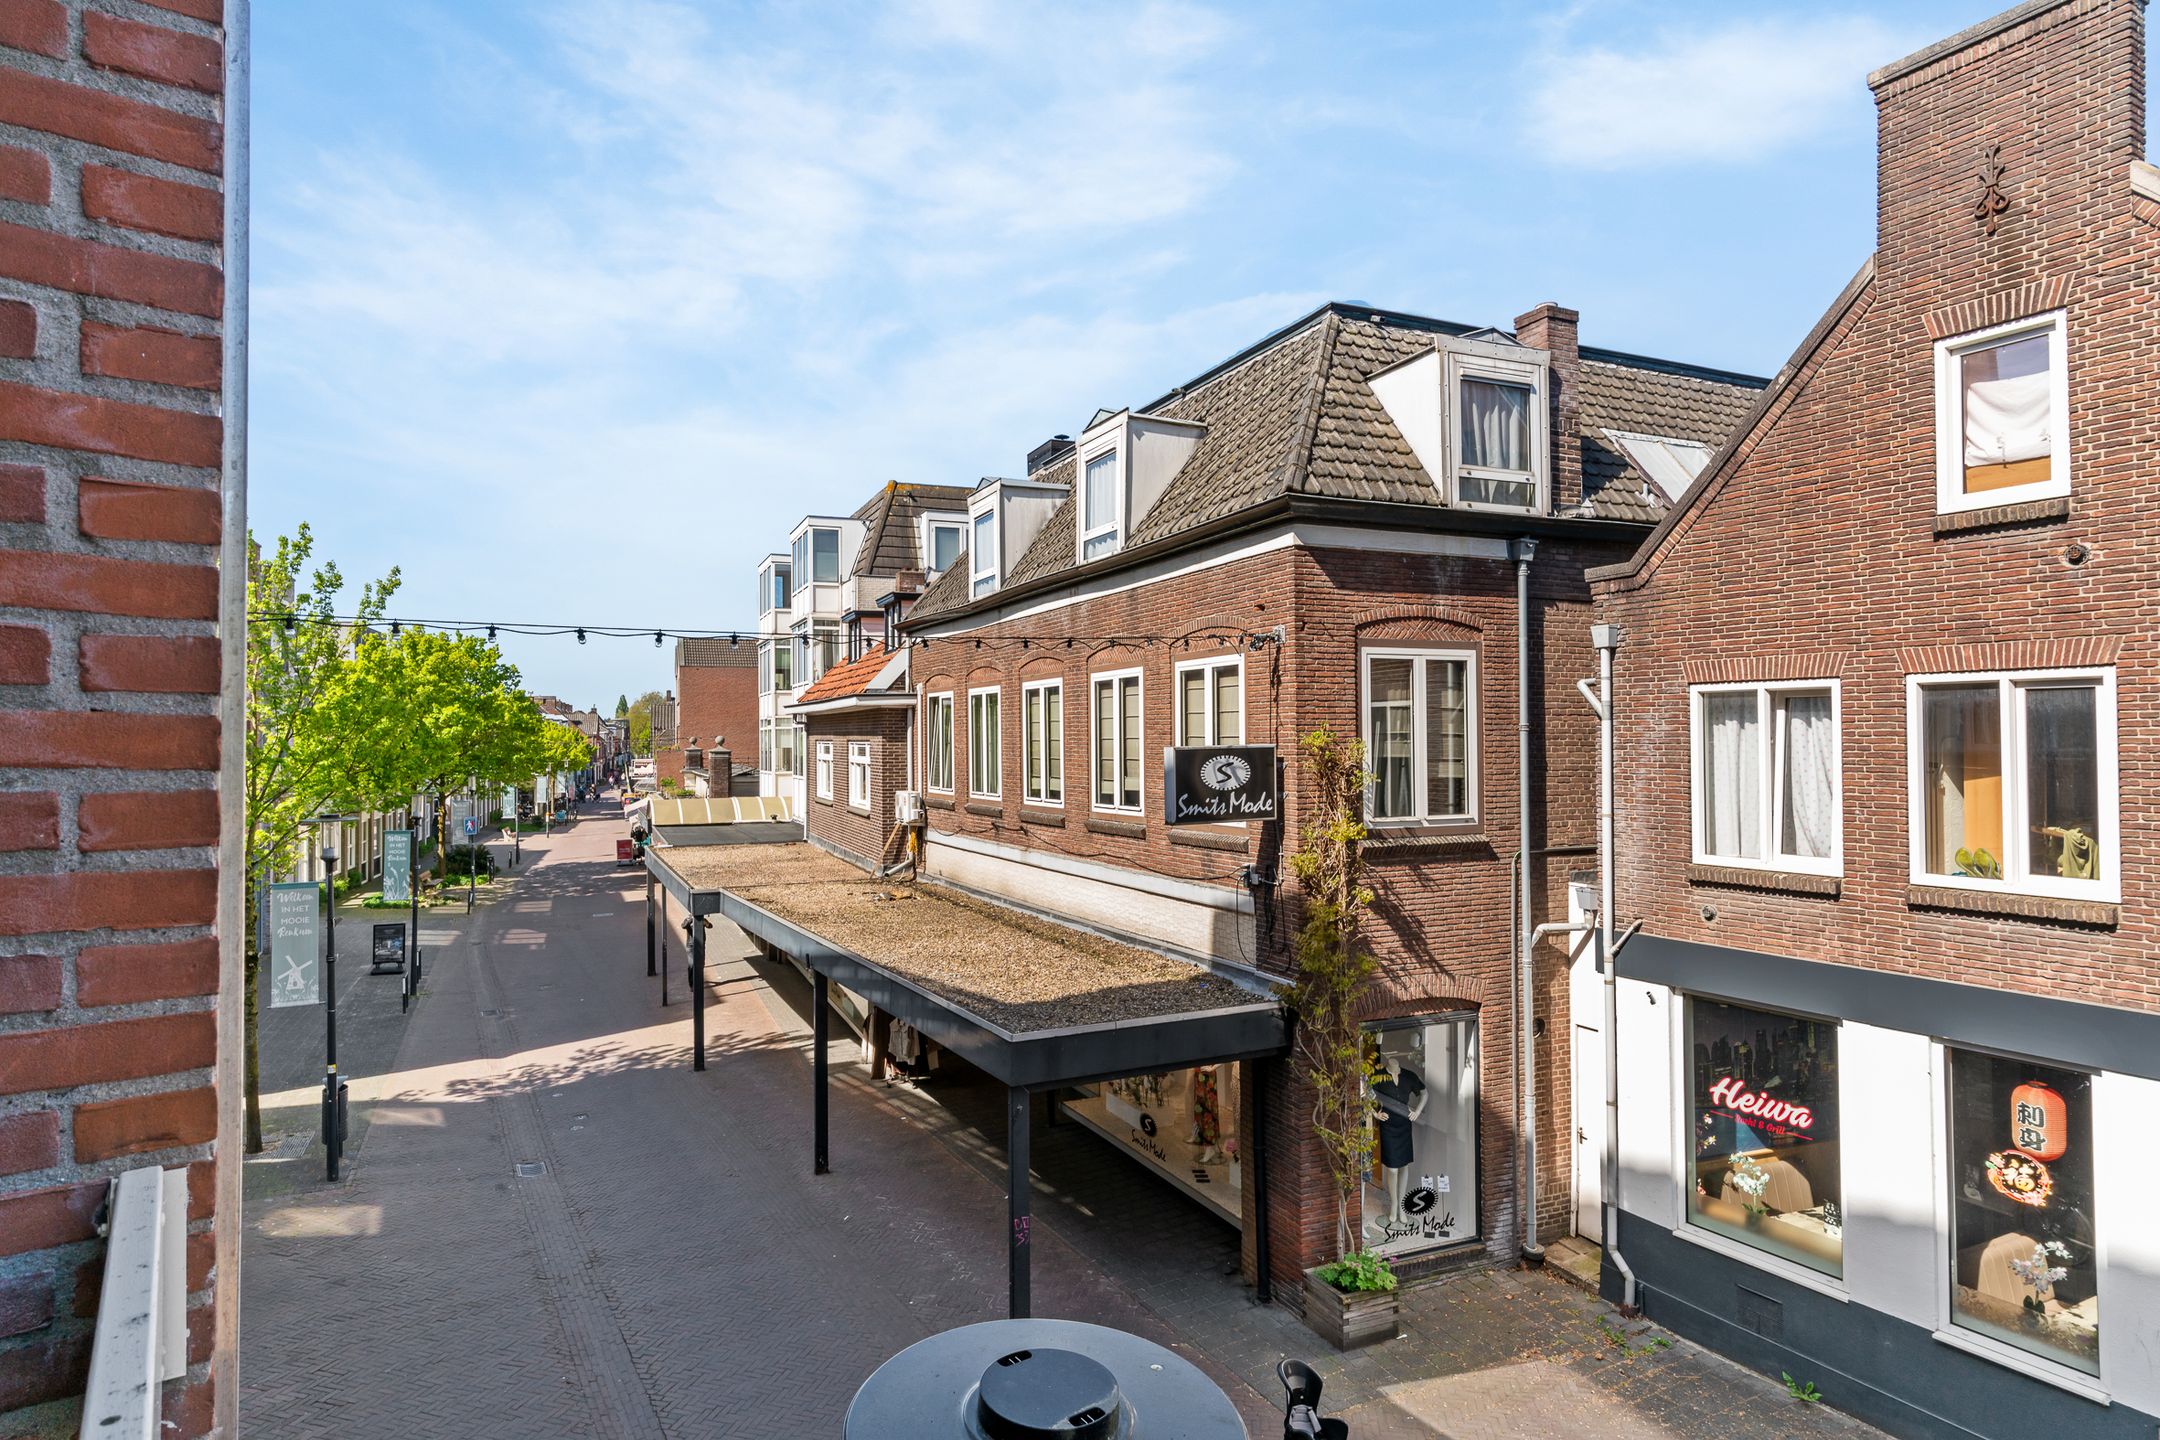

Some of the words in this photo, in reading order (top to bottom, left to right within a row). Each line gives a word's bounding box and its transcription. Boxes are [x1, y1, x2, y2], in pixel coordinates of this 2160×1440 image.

[1178, 793, 1227, 818] Smits
[1229, 791, 1273, 814] Mode
[292, 904, 310, 913] HET
[281, 916, 311, 926] MOOIE
[1709, 1076, 1813, 1129] Heiwa
[1766, 1122, 1786, 1135] Grill
[1384, 1222, 1420, 1242] Smits
[1422, 1212, 1455, 1233] Mode
